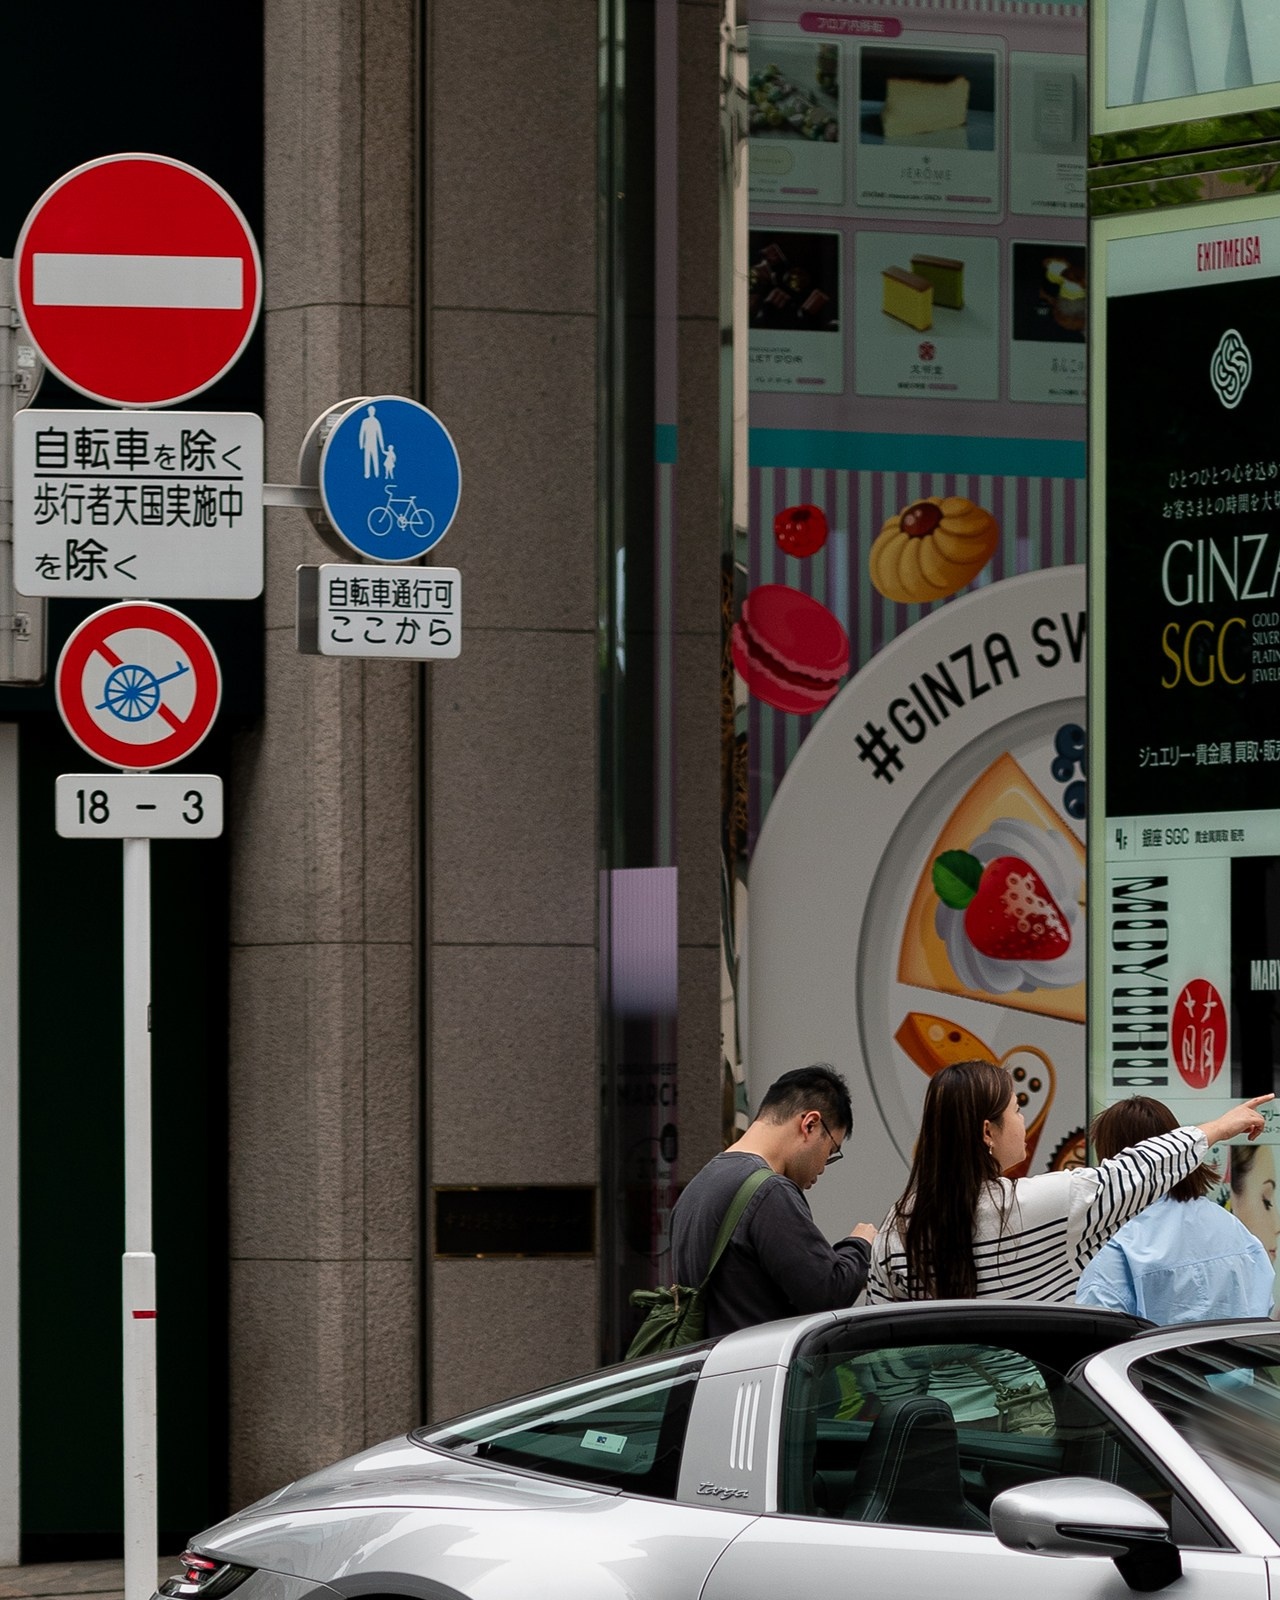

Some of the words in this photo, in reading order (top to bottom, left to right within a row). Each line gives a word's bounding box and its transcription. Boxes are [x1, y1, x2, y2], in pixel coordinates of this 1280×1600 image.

[1197, 236, 1261, 271] EXITMELSA
[34, 429, 243, 473] 自転車を除く
[34, 483, 243, 528] 歩行者天国実施中
[35, 539, 137, 581] を除く
[329, 577, 453, 609] 自転車通行可
[330, 616, 453, 646] ここから
[1252, 612, 1280, 627] GOLD
[1161, 617, 1247, 690] SGC
[1252, 630, 1280, 646] SILVER
[854, 632, 1020, 785] #GINZA
[1138, 741, 1232, 768] ジュエリー・貴金属
[77, 789, 110, 825] 18
[182, 789, 204, 825] 3
[1165, 828, 1190, 846] SGC
